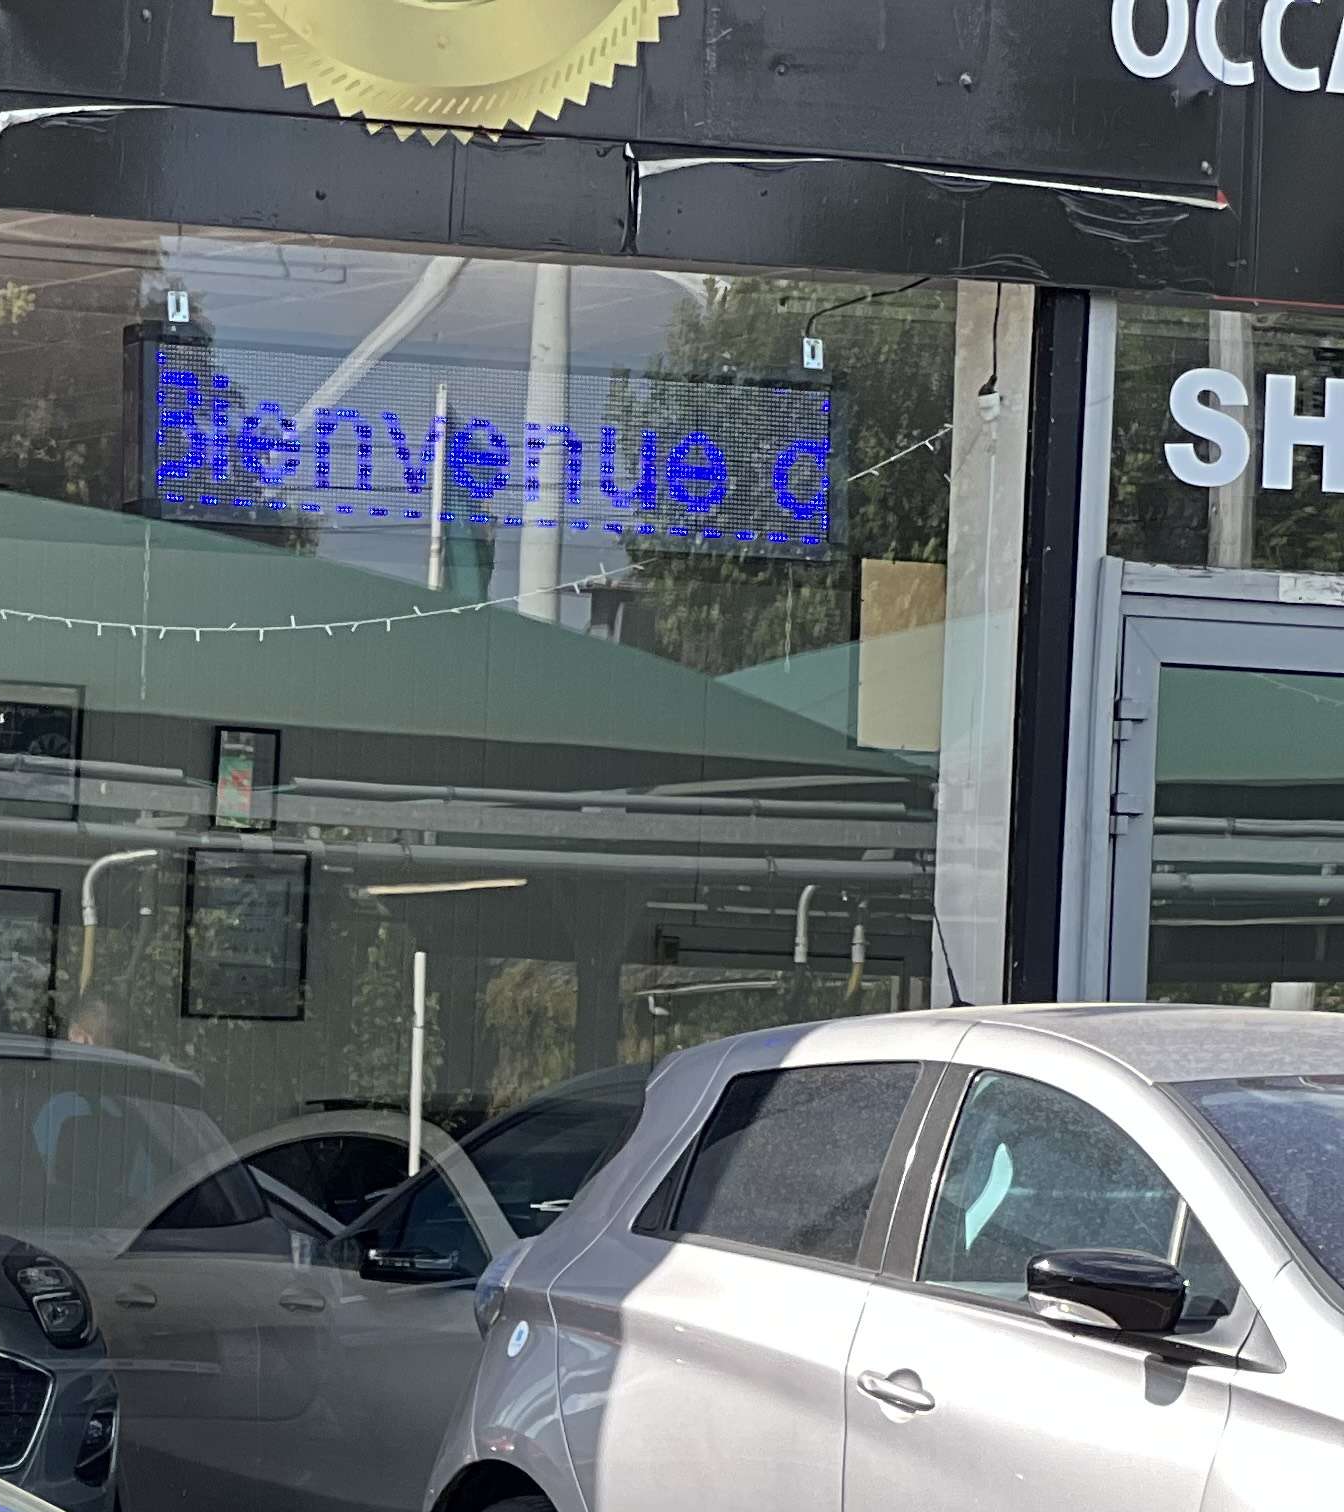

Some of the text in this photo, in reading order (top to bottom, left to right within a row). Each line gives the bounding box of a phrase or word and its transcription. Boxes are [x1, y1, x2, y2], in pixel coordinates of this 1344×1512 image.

[1111, 0, 1344, 94] OCC
[156, 370, 727, 513] Bienvenue
[1164, 367, 1344, 493] SH
